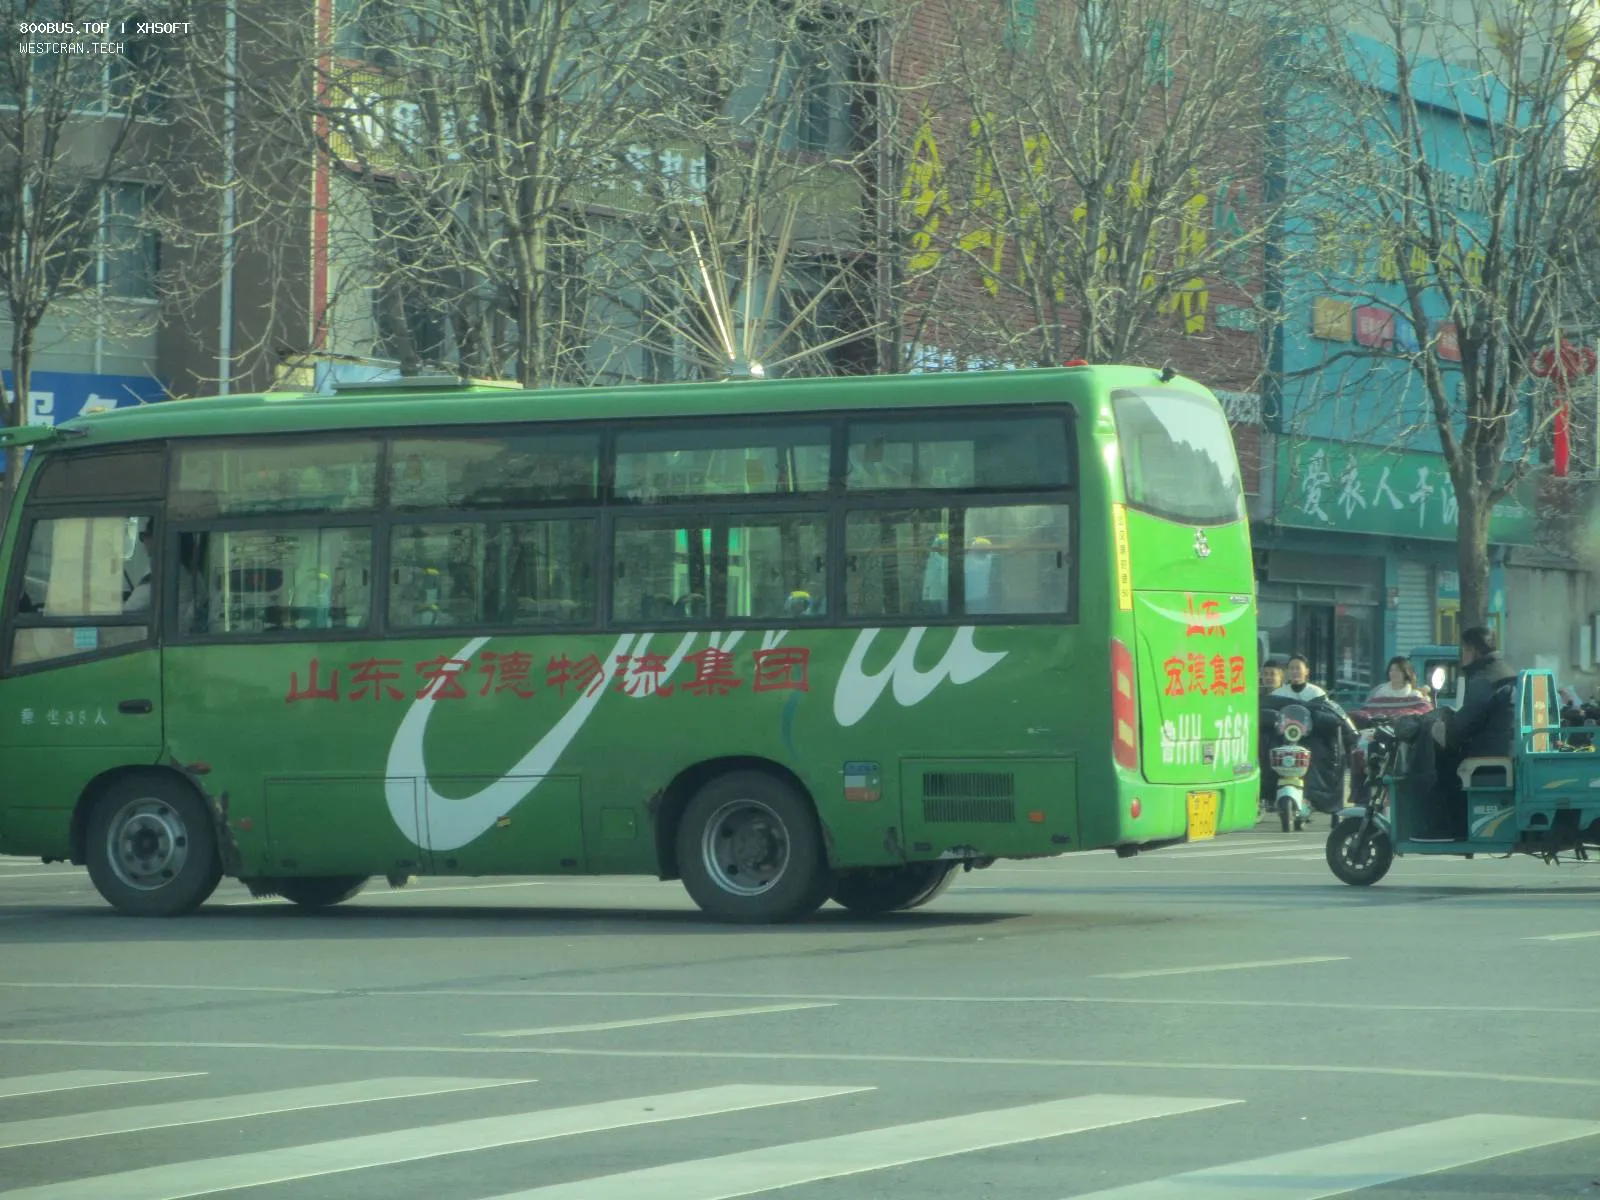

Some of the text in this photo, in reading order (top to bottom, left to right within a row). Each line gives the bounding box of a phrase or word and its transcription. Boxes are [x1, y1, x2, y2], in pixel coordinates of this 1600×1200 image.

[284, 645, 811, 704] 山东宏德物流集团
